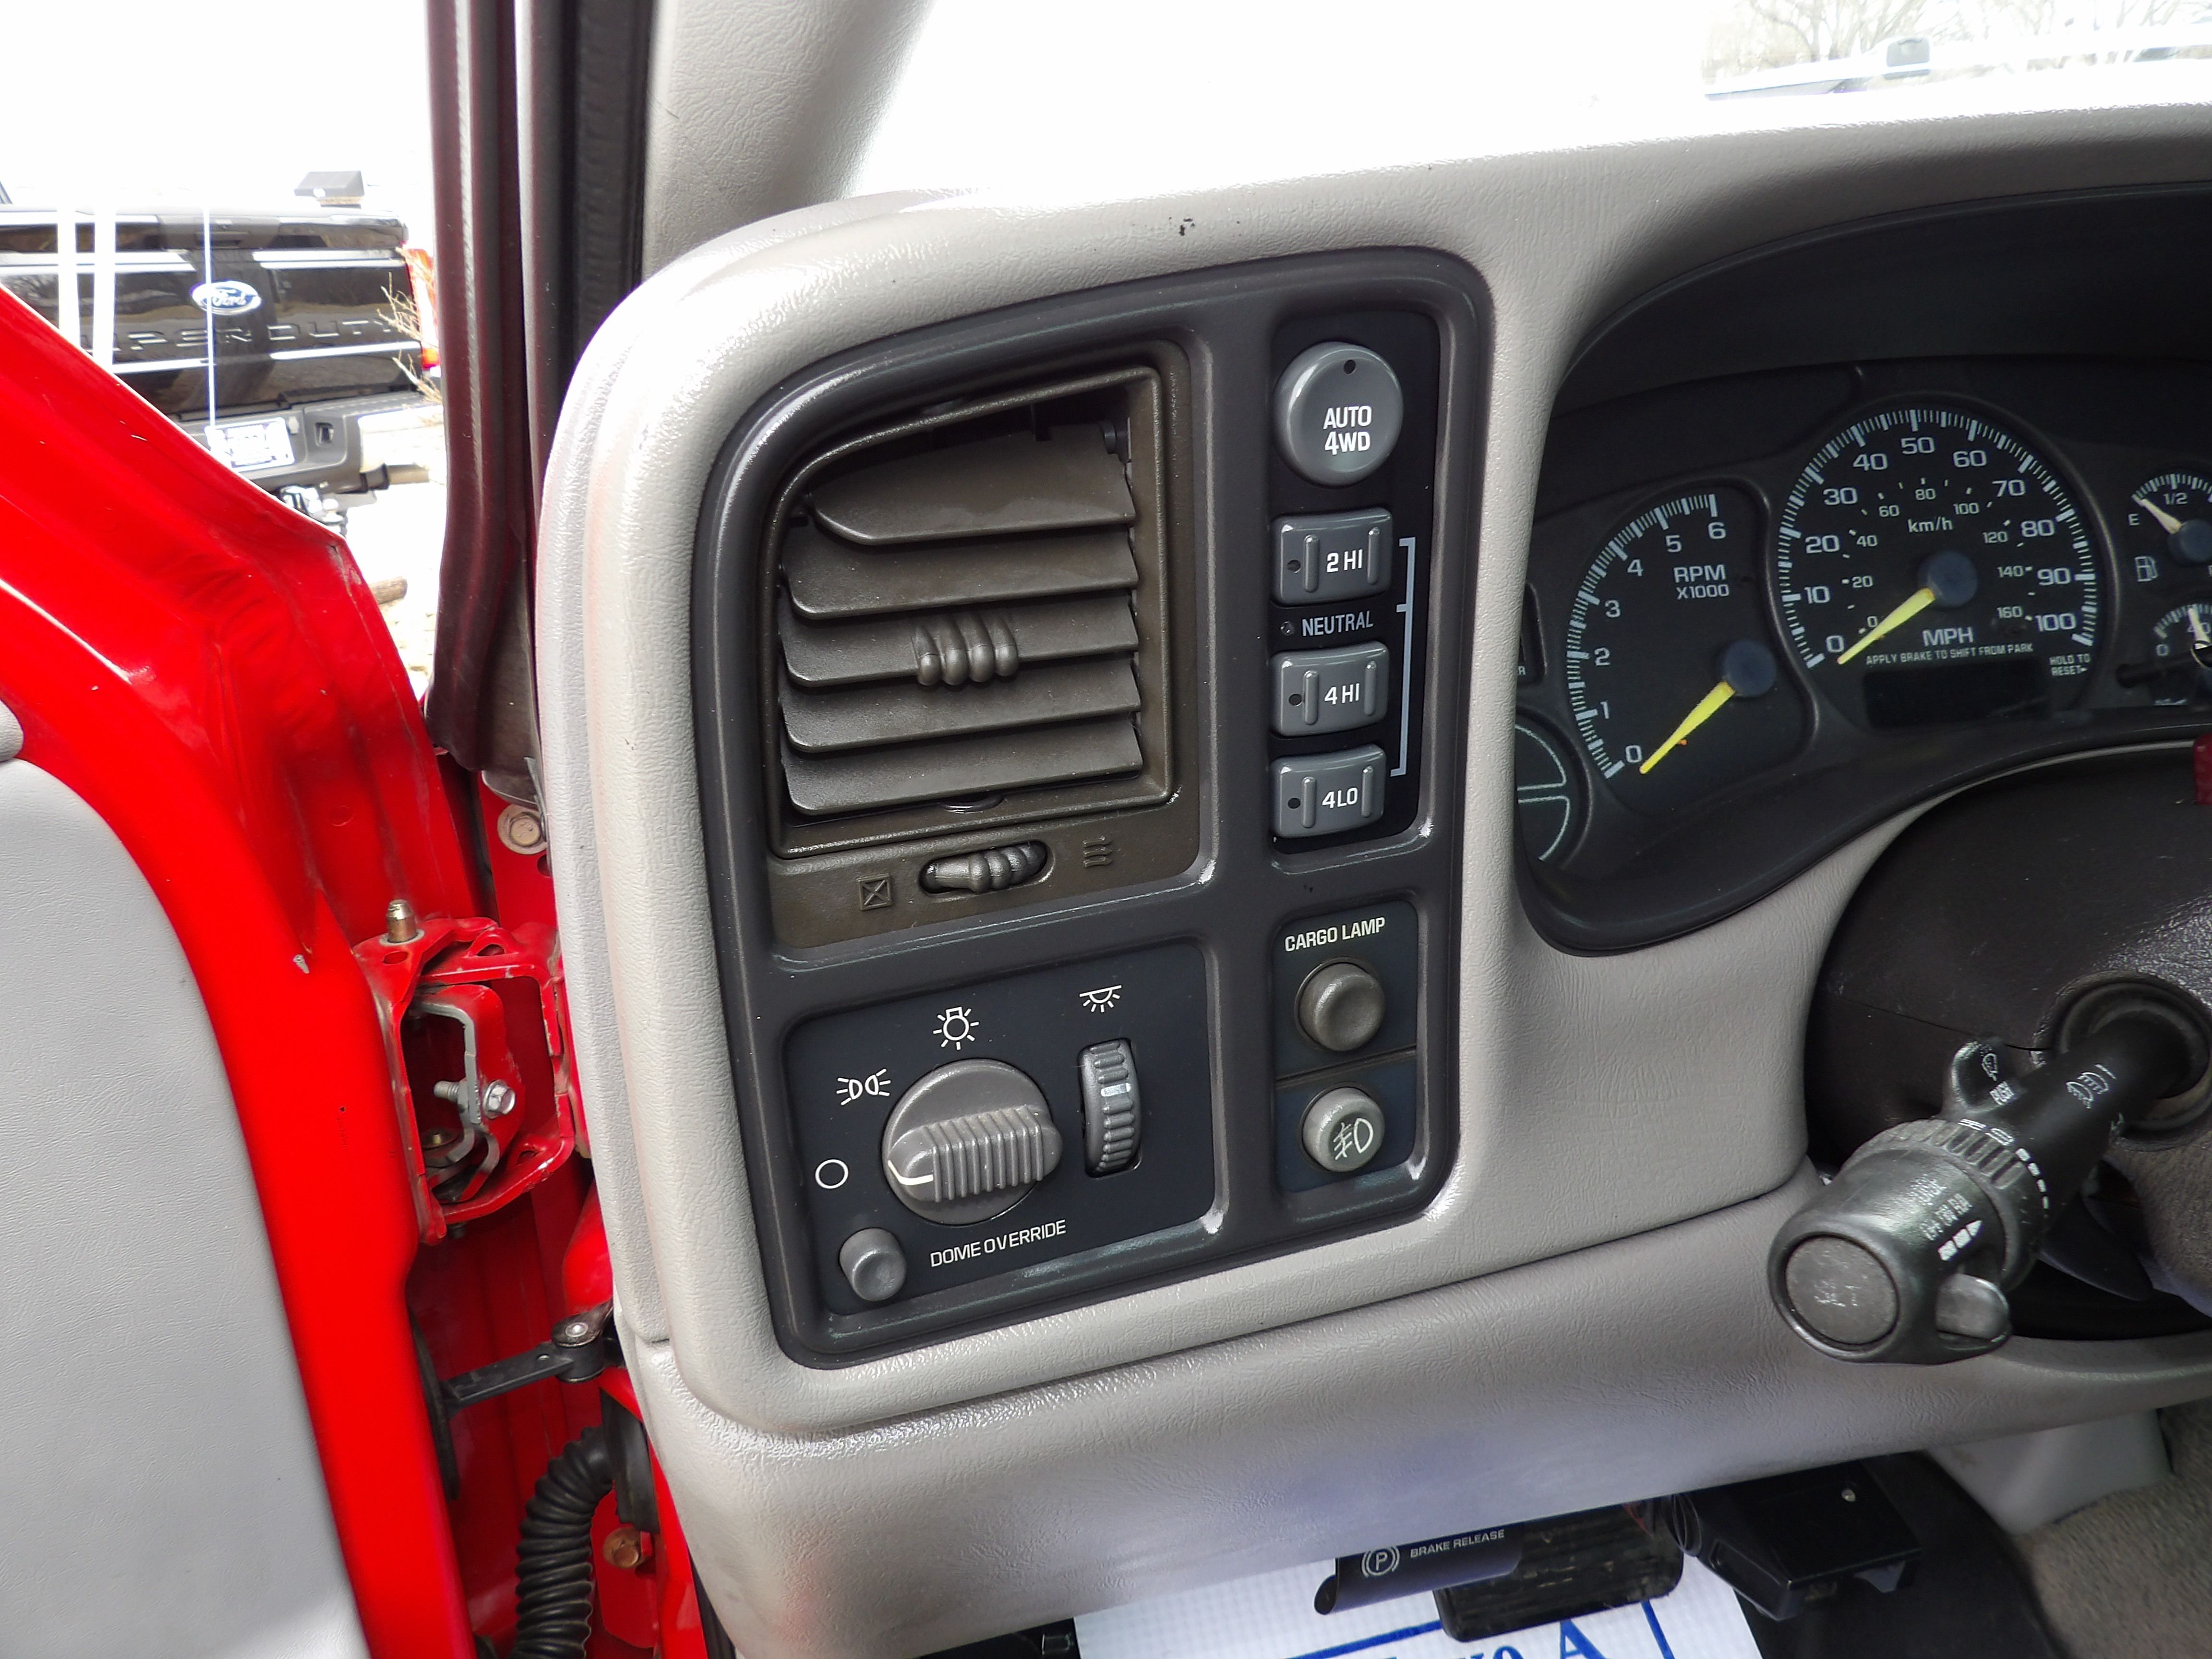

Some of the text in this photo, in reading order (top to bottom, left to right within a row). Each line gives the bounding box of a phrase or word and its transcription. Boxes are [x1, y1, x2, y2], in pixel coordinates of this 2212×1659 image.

[1322, 405, 1372, 430] AUTO
[1324, 431, 1370, 455] 4WD
[1900, 437, 1935, 454] 50
[1852, 453, 1888, 471] 40
[1953, 450, 1987, 468] 60
[1823, 487, 1858, 505] 30
[1914, 488, 1936, 500] 80
[1992, 480, 2026, 497] 70
[2164, 492, 2188, 505] 1/2
[1878, 505, 1900, 517] 60
[1953, 503, 1980, 515] 100
[1907, 517, 1953, 532] km/h
[2021, 519, 2056, 537] 80
[2128, 514, 2140, 526] E
[1707, 522, 1726, 540] 6
[1983, 531, 2008, 543] 120
[1666, 535, 1682, 553] 5
[1805, 535, 1840, 553] 20
[1856, 535, 1878, 547] 40
[1326, 549, 1363, 573] 2 HI
[1627, 559, 1643, 576] 4
[1674, 564, 1726, 583] RPM
[1997, 565, 2024, 578] 140
[2037, 567, 2071, 586] 90
[1852, 576, 1874, 589] 20
[1676, 584, 1730, 600] X1000
[1804, 586, 1830, 604] 10
[1604, 600, 1621, 618] 3
[1996, 606, 2023, 619] 160
[1302, 610, 1374, 637] NEUTRAL
[1867, 616, 1878, 628] 0
[2035, 613, 2077, 632] 100
[1826, 635, 1845, 653] 0
[1922, 626, 1974, 647] MPH
[1594, 647, 1610, 666] 2
[1866, 643, 2033, 665] APPLY BRAKE TO SHIFT FROM PARK
[2049, 653, 2092, 666] HOLD TO
[2051, 665, 2081, 676] RESET
[1324, 683, 1360, 705] 4 HI
[1600, 700, 1609, 719] 1
[1625, 745, 1642, 763] 0
[1322, 787, 1358, 809] 4LO
[1285, 917, 1386, 952] CARGO LAMP
[930, 1219, 1067, 1267] DOME OVERRIDE
[1410, 1541, 1450, 1558] BRAKE
[1453, 1529, 1505, 1549] RELEASE
